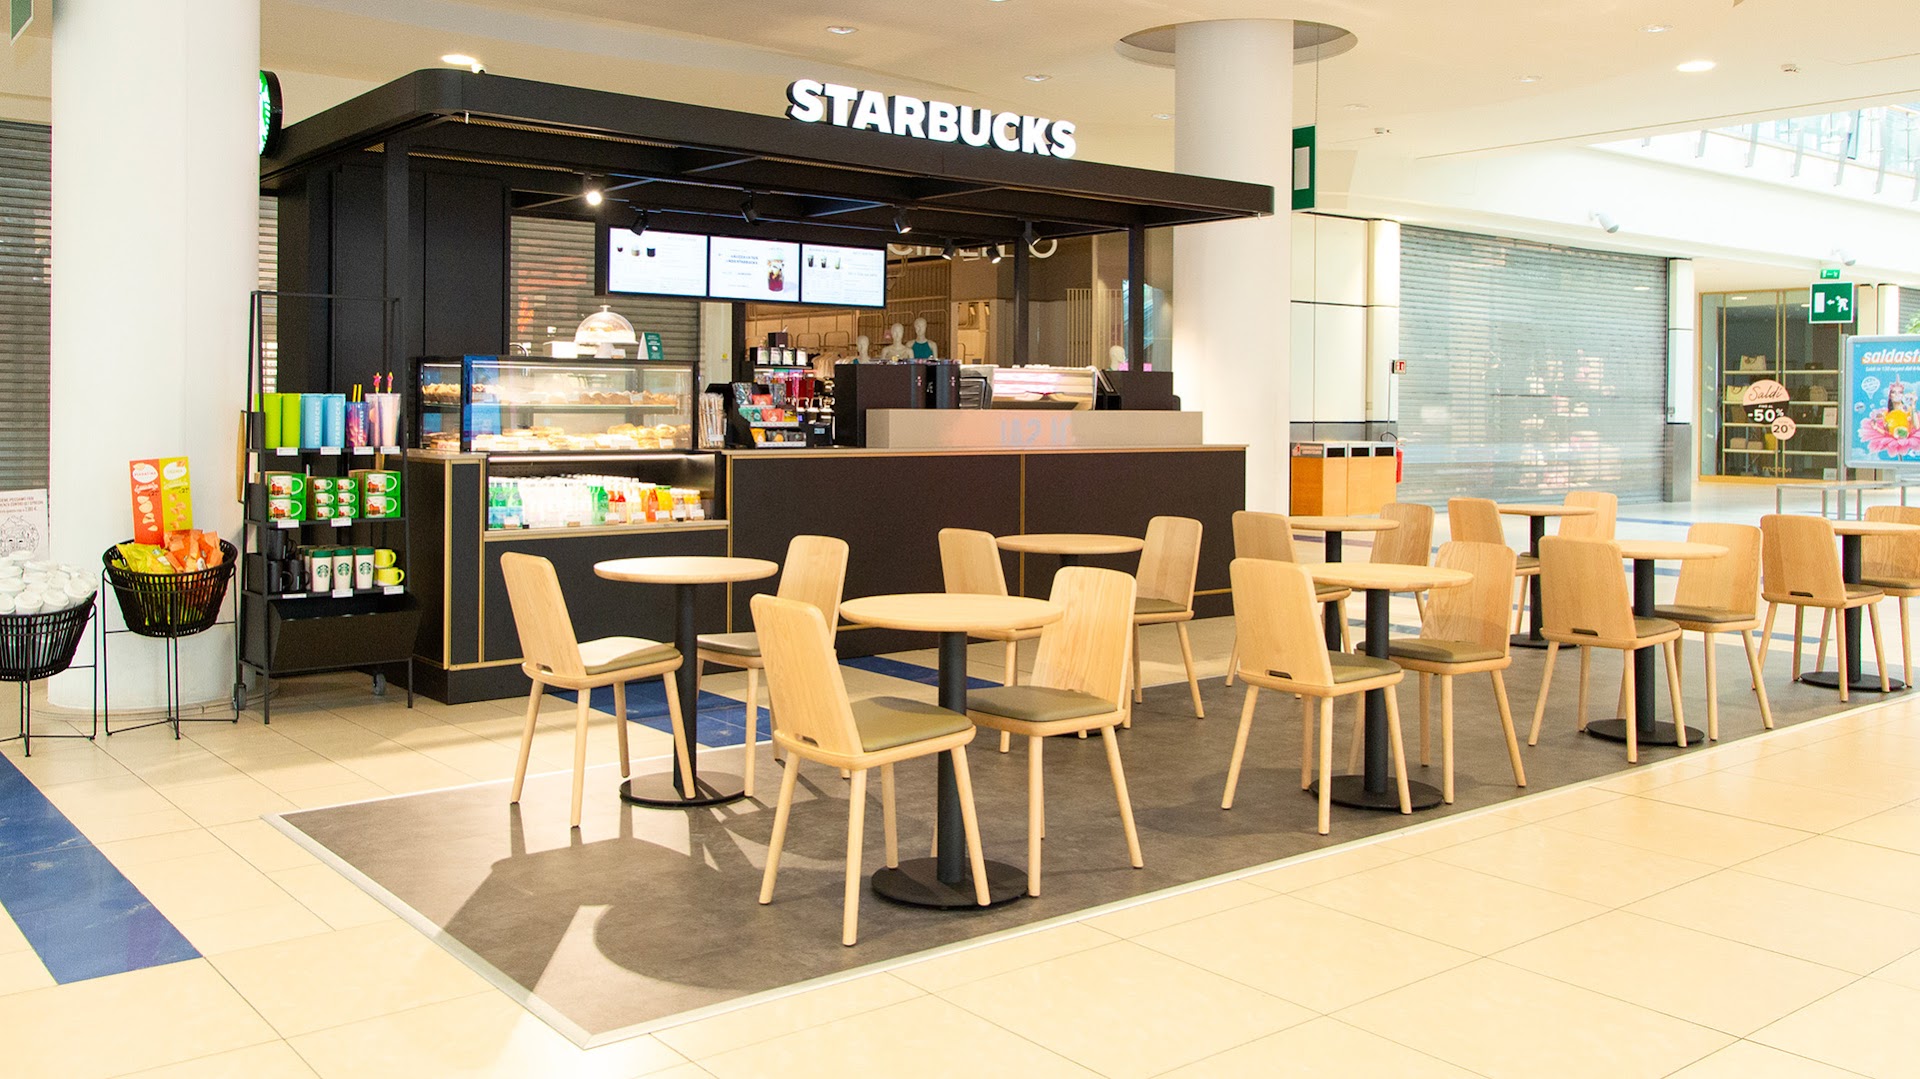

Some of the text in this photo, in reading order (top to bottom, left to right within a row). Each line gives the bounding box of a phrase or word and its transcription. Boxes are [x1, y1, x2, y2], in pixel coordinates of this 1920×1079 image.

[789, 79, 1076, 159] STARBUCKS
[1862, 348, 1920, 364] saldast
[1749, 385, 1782, 400] Saldi
